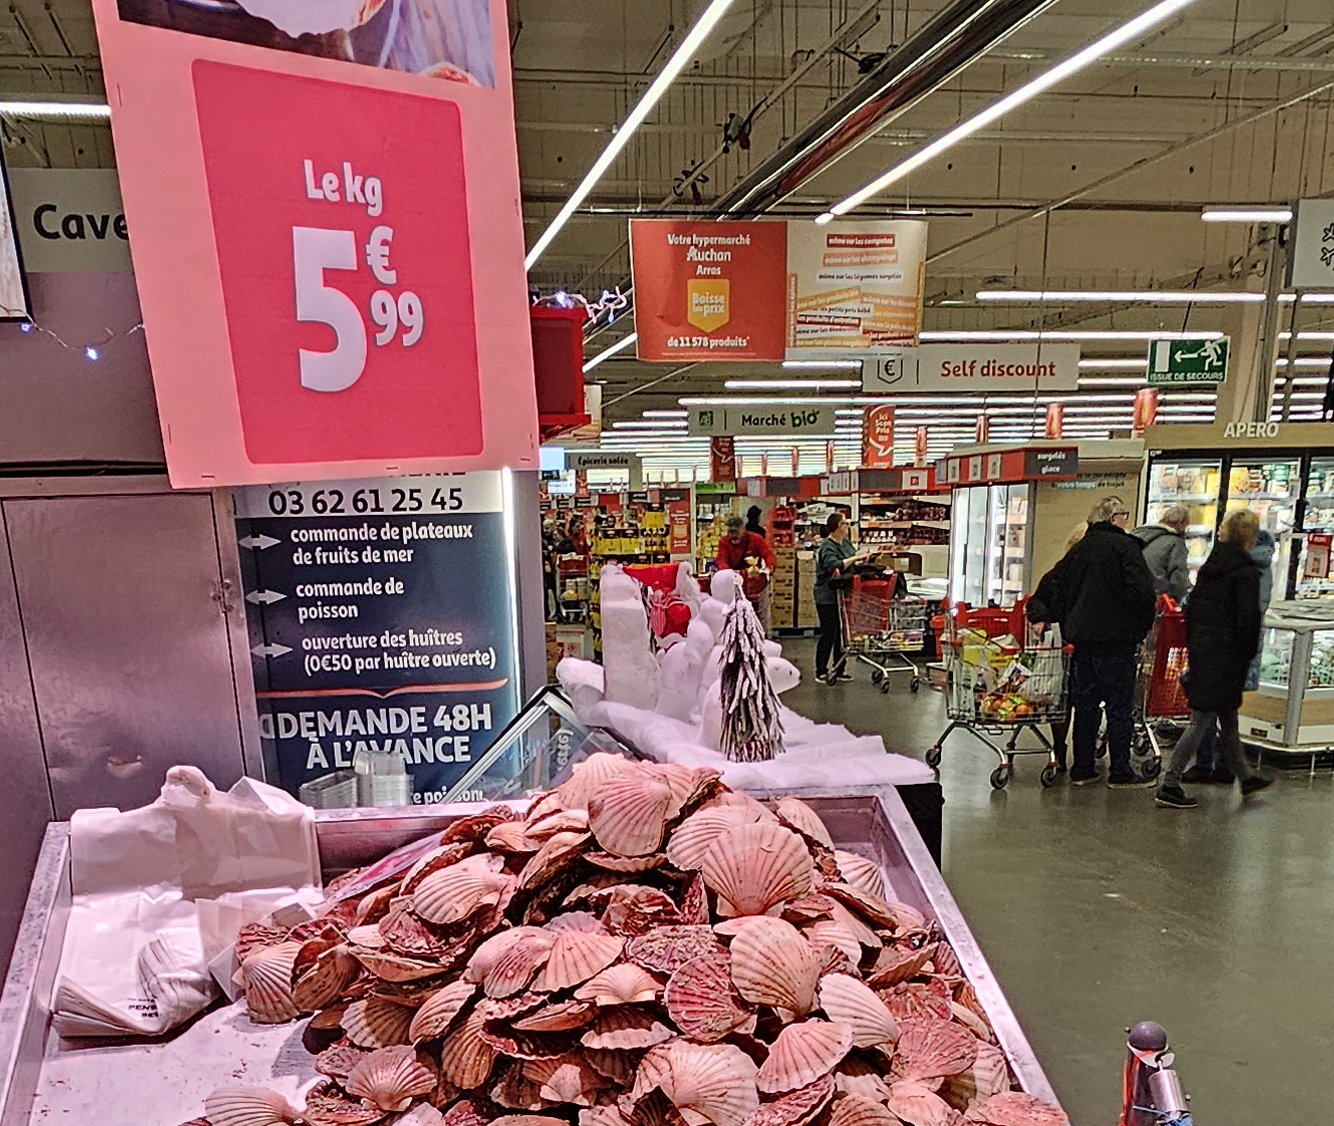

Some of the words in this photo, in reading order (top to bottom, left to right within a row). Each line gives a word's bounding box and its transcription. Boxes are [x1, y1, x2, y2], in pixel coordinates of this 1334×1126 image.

[303, 159, 340, 203] Le
[342, 161, 383, 217] kg
[33, 203, 130, 240] Cave
[667, 234, 691, 245] Votre
[693, 234, 751, 248] hypermarché
[687, 246, 731, 262] Auchan
[696, 265, 721, 275] Arras
[667, 337, 679, 347] de
[679, 337, 692, 347] 11
[941, 359, 977, 378] Self
[980, 358, 1056, 378] discount
[1149, 372, 1172, 381] ISSUE
[1174, 373, 1186, 381] DE
[1187, 371, 1224, 381] SECOURS
[741, 411, 787, 427] Marché
[790, 410, 820, 428] bio
[1037, 451, 1066, 462] surgelés
[1041, 465, 1061, 475] glace
[268, 490, 305, 515] 03
[310, 490, 346, 514] 62
[351, 489, 385, 513] 61
[391, 488, 423, 512] 25
[430, 487, 463, 511] 45
[290, 523, 379, 543] commande
[380, 522, 401, 540] de
[402, 522, 474, 545] plateaux
[292, 548, 313, 566] de
[315, 546, 360, 566] fruits
[361, 546, 381, 564] de
[383, 548, 414, 563] mer
[295, 579, 383, 598] commande
[384, 577, 404, 595] de
[297, 603, 359, 624] poisson
[301, 631, 378, 651] ouverture
[380, 630, 406, 648] des
[408, 629, 463, 647] huîtres
[303, 655, 352, 677] (0€50
[354, 656, 382, 675] par
[383, 651, 430, 671] huître
[432, 647, 497, 670] ouverte)
[278, 706, 428, 740] DEMANDE
[433, 703, 492, 732] 48H
[305, 732, 329, 770] À
